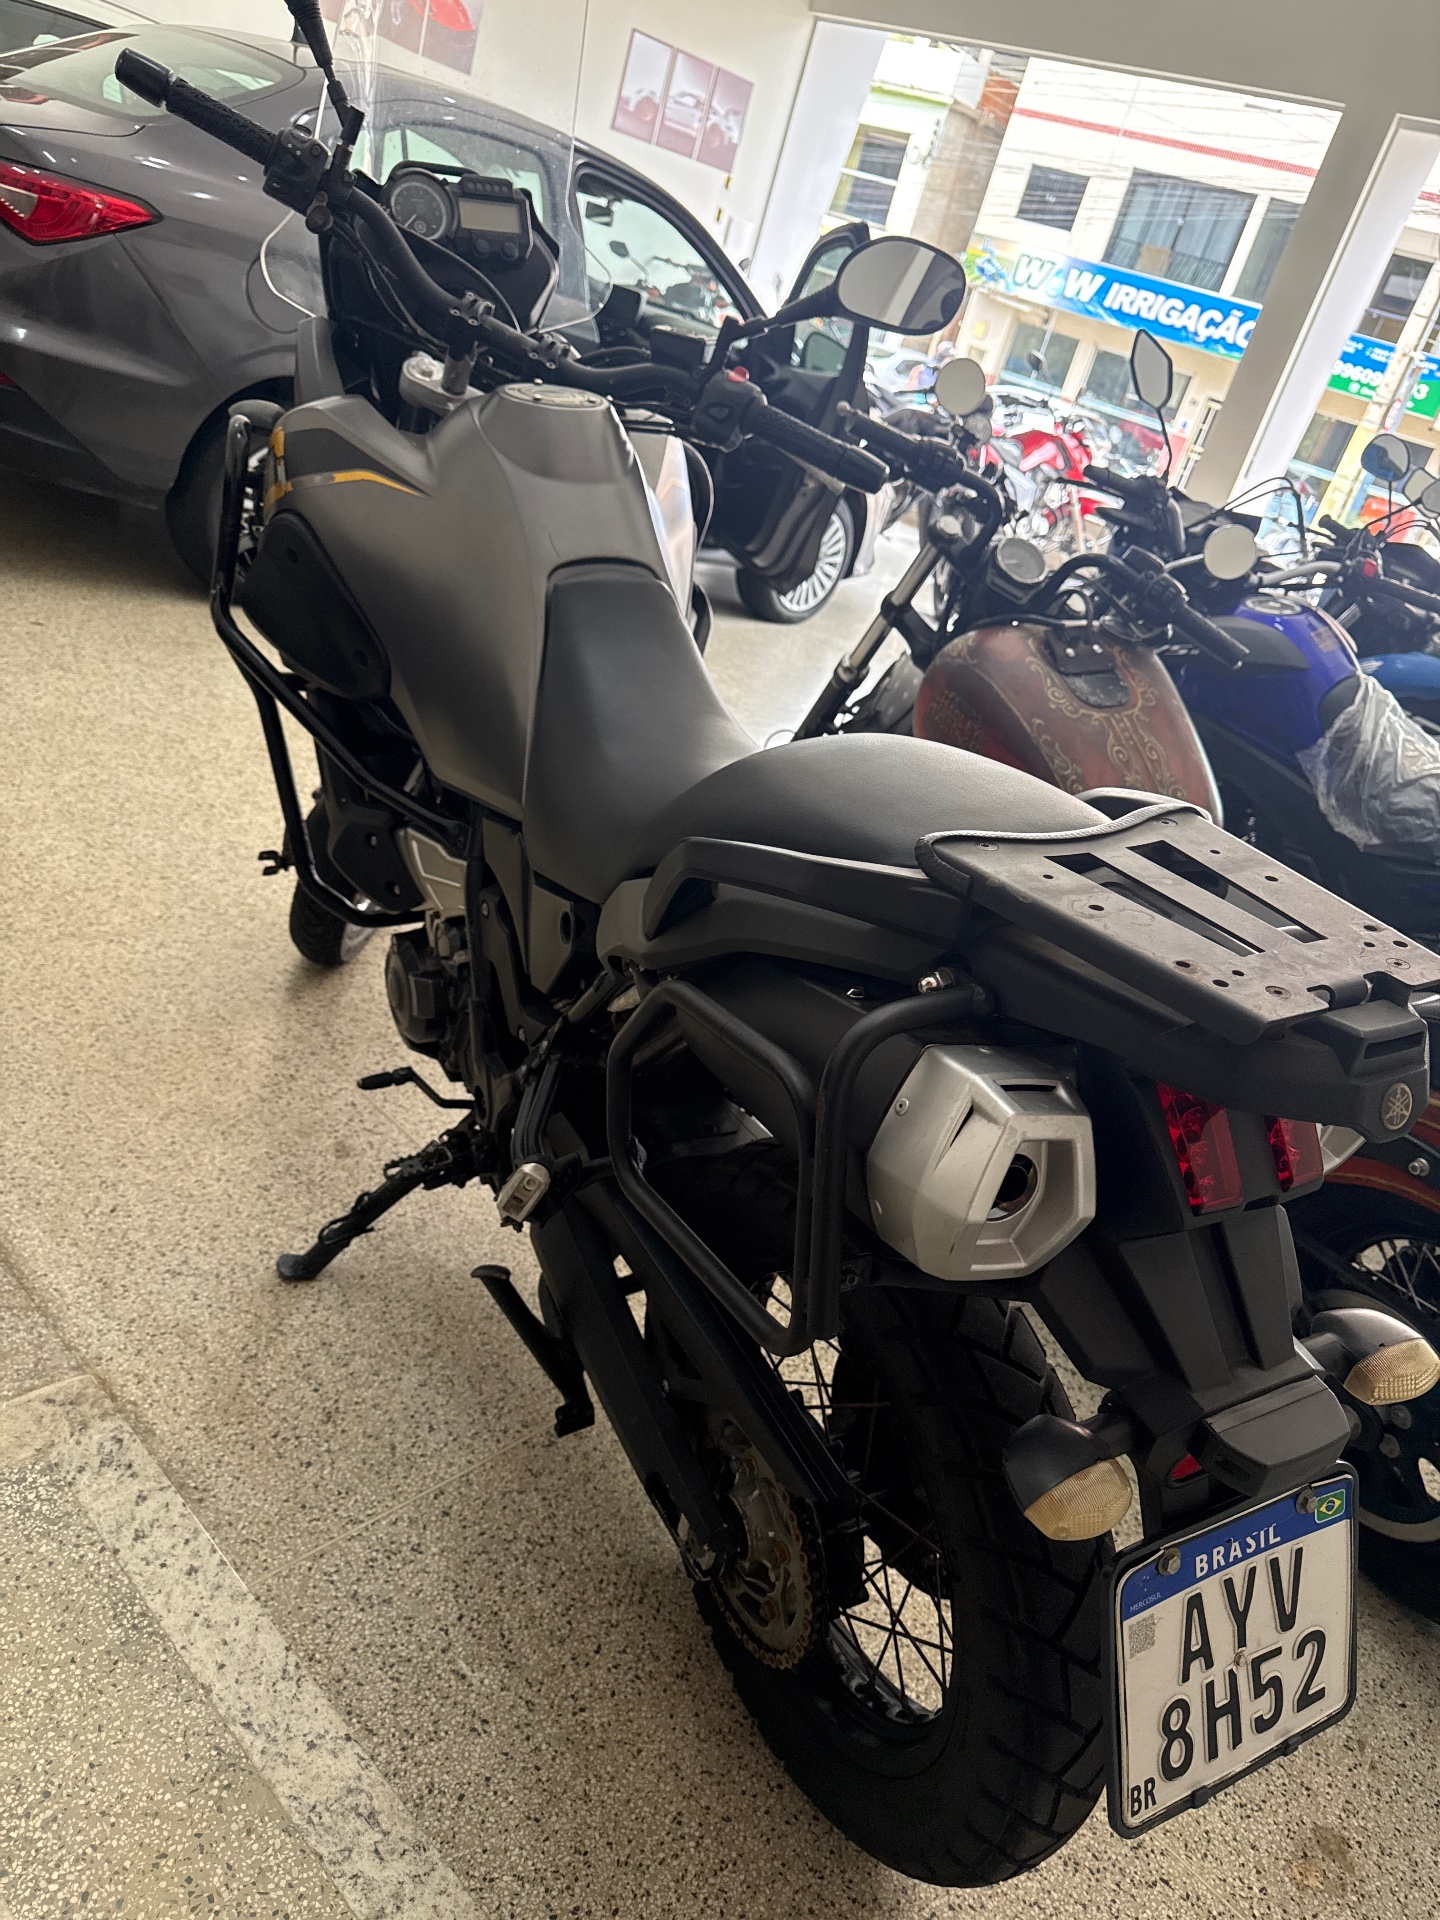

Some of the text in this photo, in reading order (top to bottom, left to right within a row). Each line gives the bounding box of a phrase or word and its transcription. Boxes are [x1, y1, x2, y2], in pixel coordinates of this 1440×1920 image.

[1195, 1524, 1281, 1578] BRASIL
[1129, 1592, 1162, 1613] MERCOSUL
[1181, 1547, 1304, 1685] AYV
[1160, 1629, 1327, 1782] 8H52
[1130, 1776, 1157, 1817] BR
